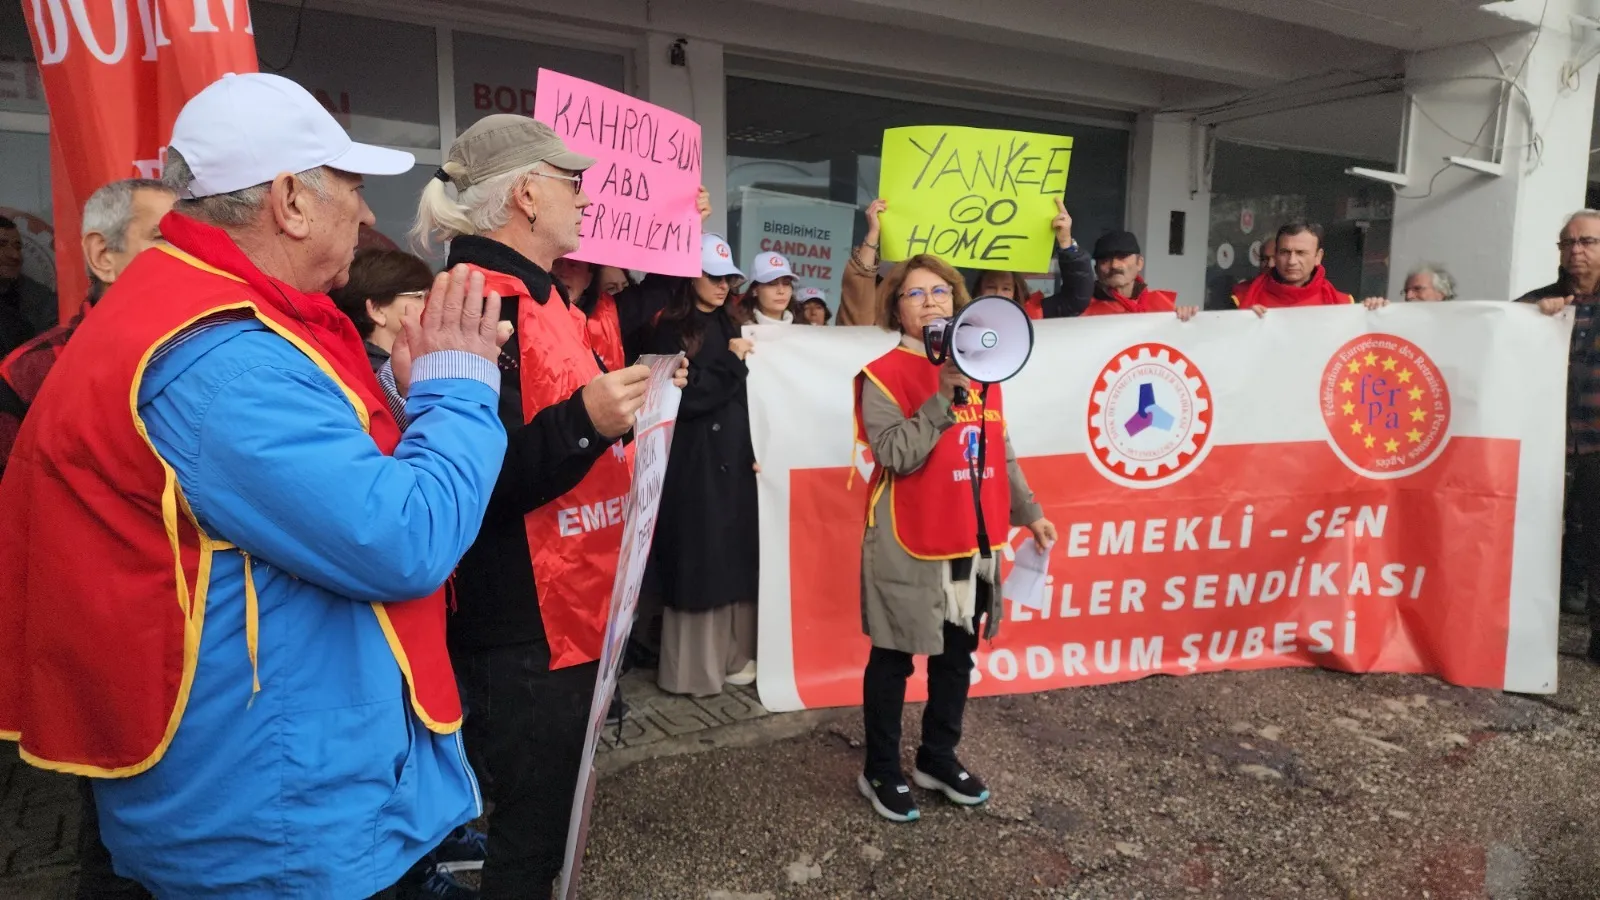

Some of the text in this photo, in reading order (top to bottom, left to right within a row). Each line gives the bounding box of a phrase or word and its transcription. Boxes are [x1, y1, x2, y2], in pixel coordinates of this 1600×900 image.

[553, 88, 700, 173] KAHROLSUN
[600, 162, 649, 201] ABD
[909, 132, 1072, 197] YANKEE
[949, 194, 1018, 226] GO
[760, 238, 832, 260] CANDAN
[763, 220, 831, 240] BİRBİRİMİZE
[907, 224, 1028, 261] HOME
[791, 261, 832, 280] LIYIZ
[1340, 339, 1398, 361] Européenne
[1399, 345, 1414, 360] des
[1067, 505, 1254, 558] EMEKLİ
[1270, 529, 1288, 538] -
[1301, 505, 1388, 544] SEN
[1010, 557, 1426, 622] LİLER SENDİKASI
[1178, 611, 1357, 671] ŞUBESİ
